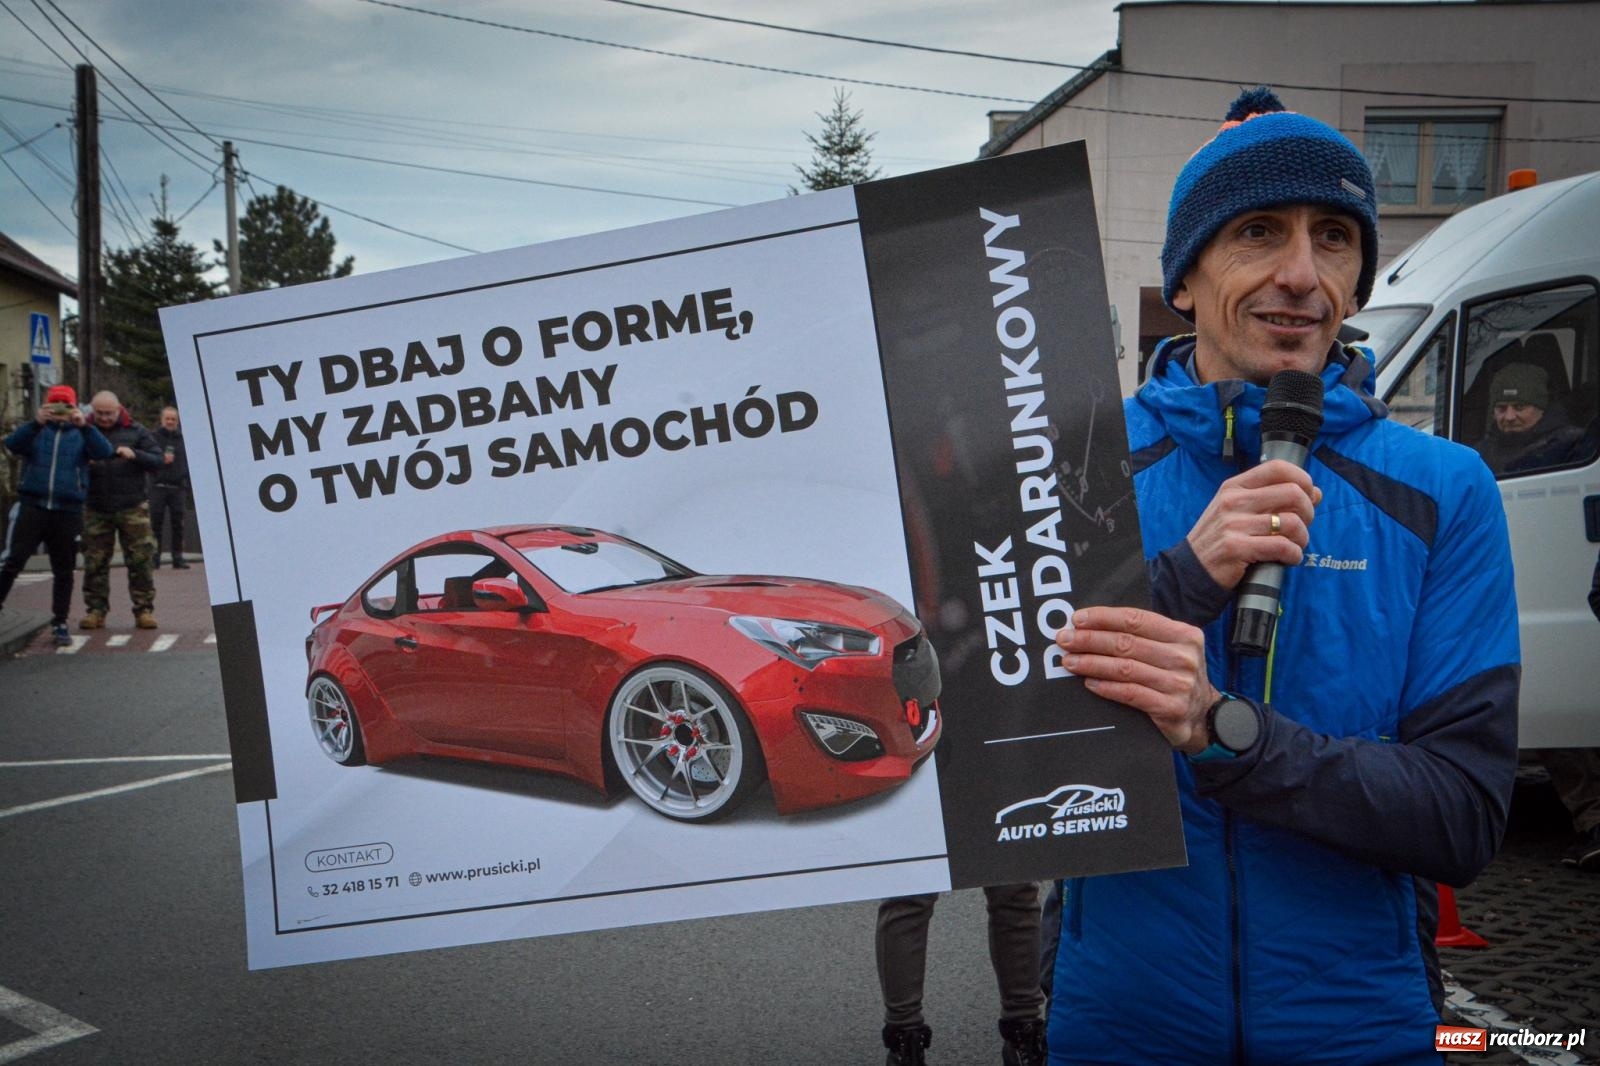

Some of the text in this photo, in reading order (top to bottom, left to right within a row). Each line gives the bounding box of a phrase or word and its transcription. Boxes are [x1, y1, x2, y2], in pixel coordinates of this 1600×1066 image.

[236, 287, 754, 407] TY DBAJ O FORMĘ,
[248, 364, 618, 461] MY ZADBAMY
[258, 385, 819, 513] O TWÓJ SAMOCHÓD
[979, 207, 1077, 680] PODARUNKOWY
[1319, 555, 1368, 570] simond
[974, 535, 1030, 686] CZEK
[1046, 784, 1121, 819] Prusicki
[997, 814, 1128, 842] AUTO SERWIS
[317, 848, 382, 867] KONTAKT
[425, 858, 541, 883] www.prusicki.pl
[322, 876, 399, 896] 32 418 15 71
